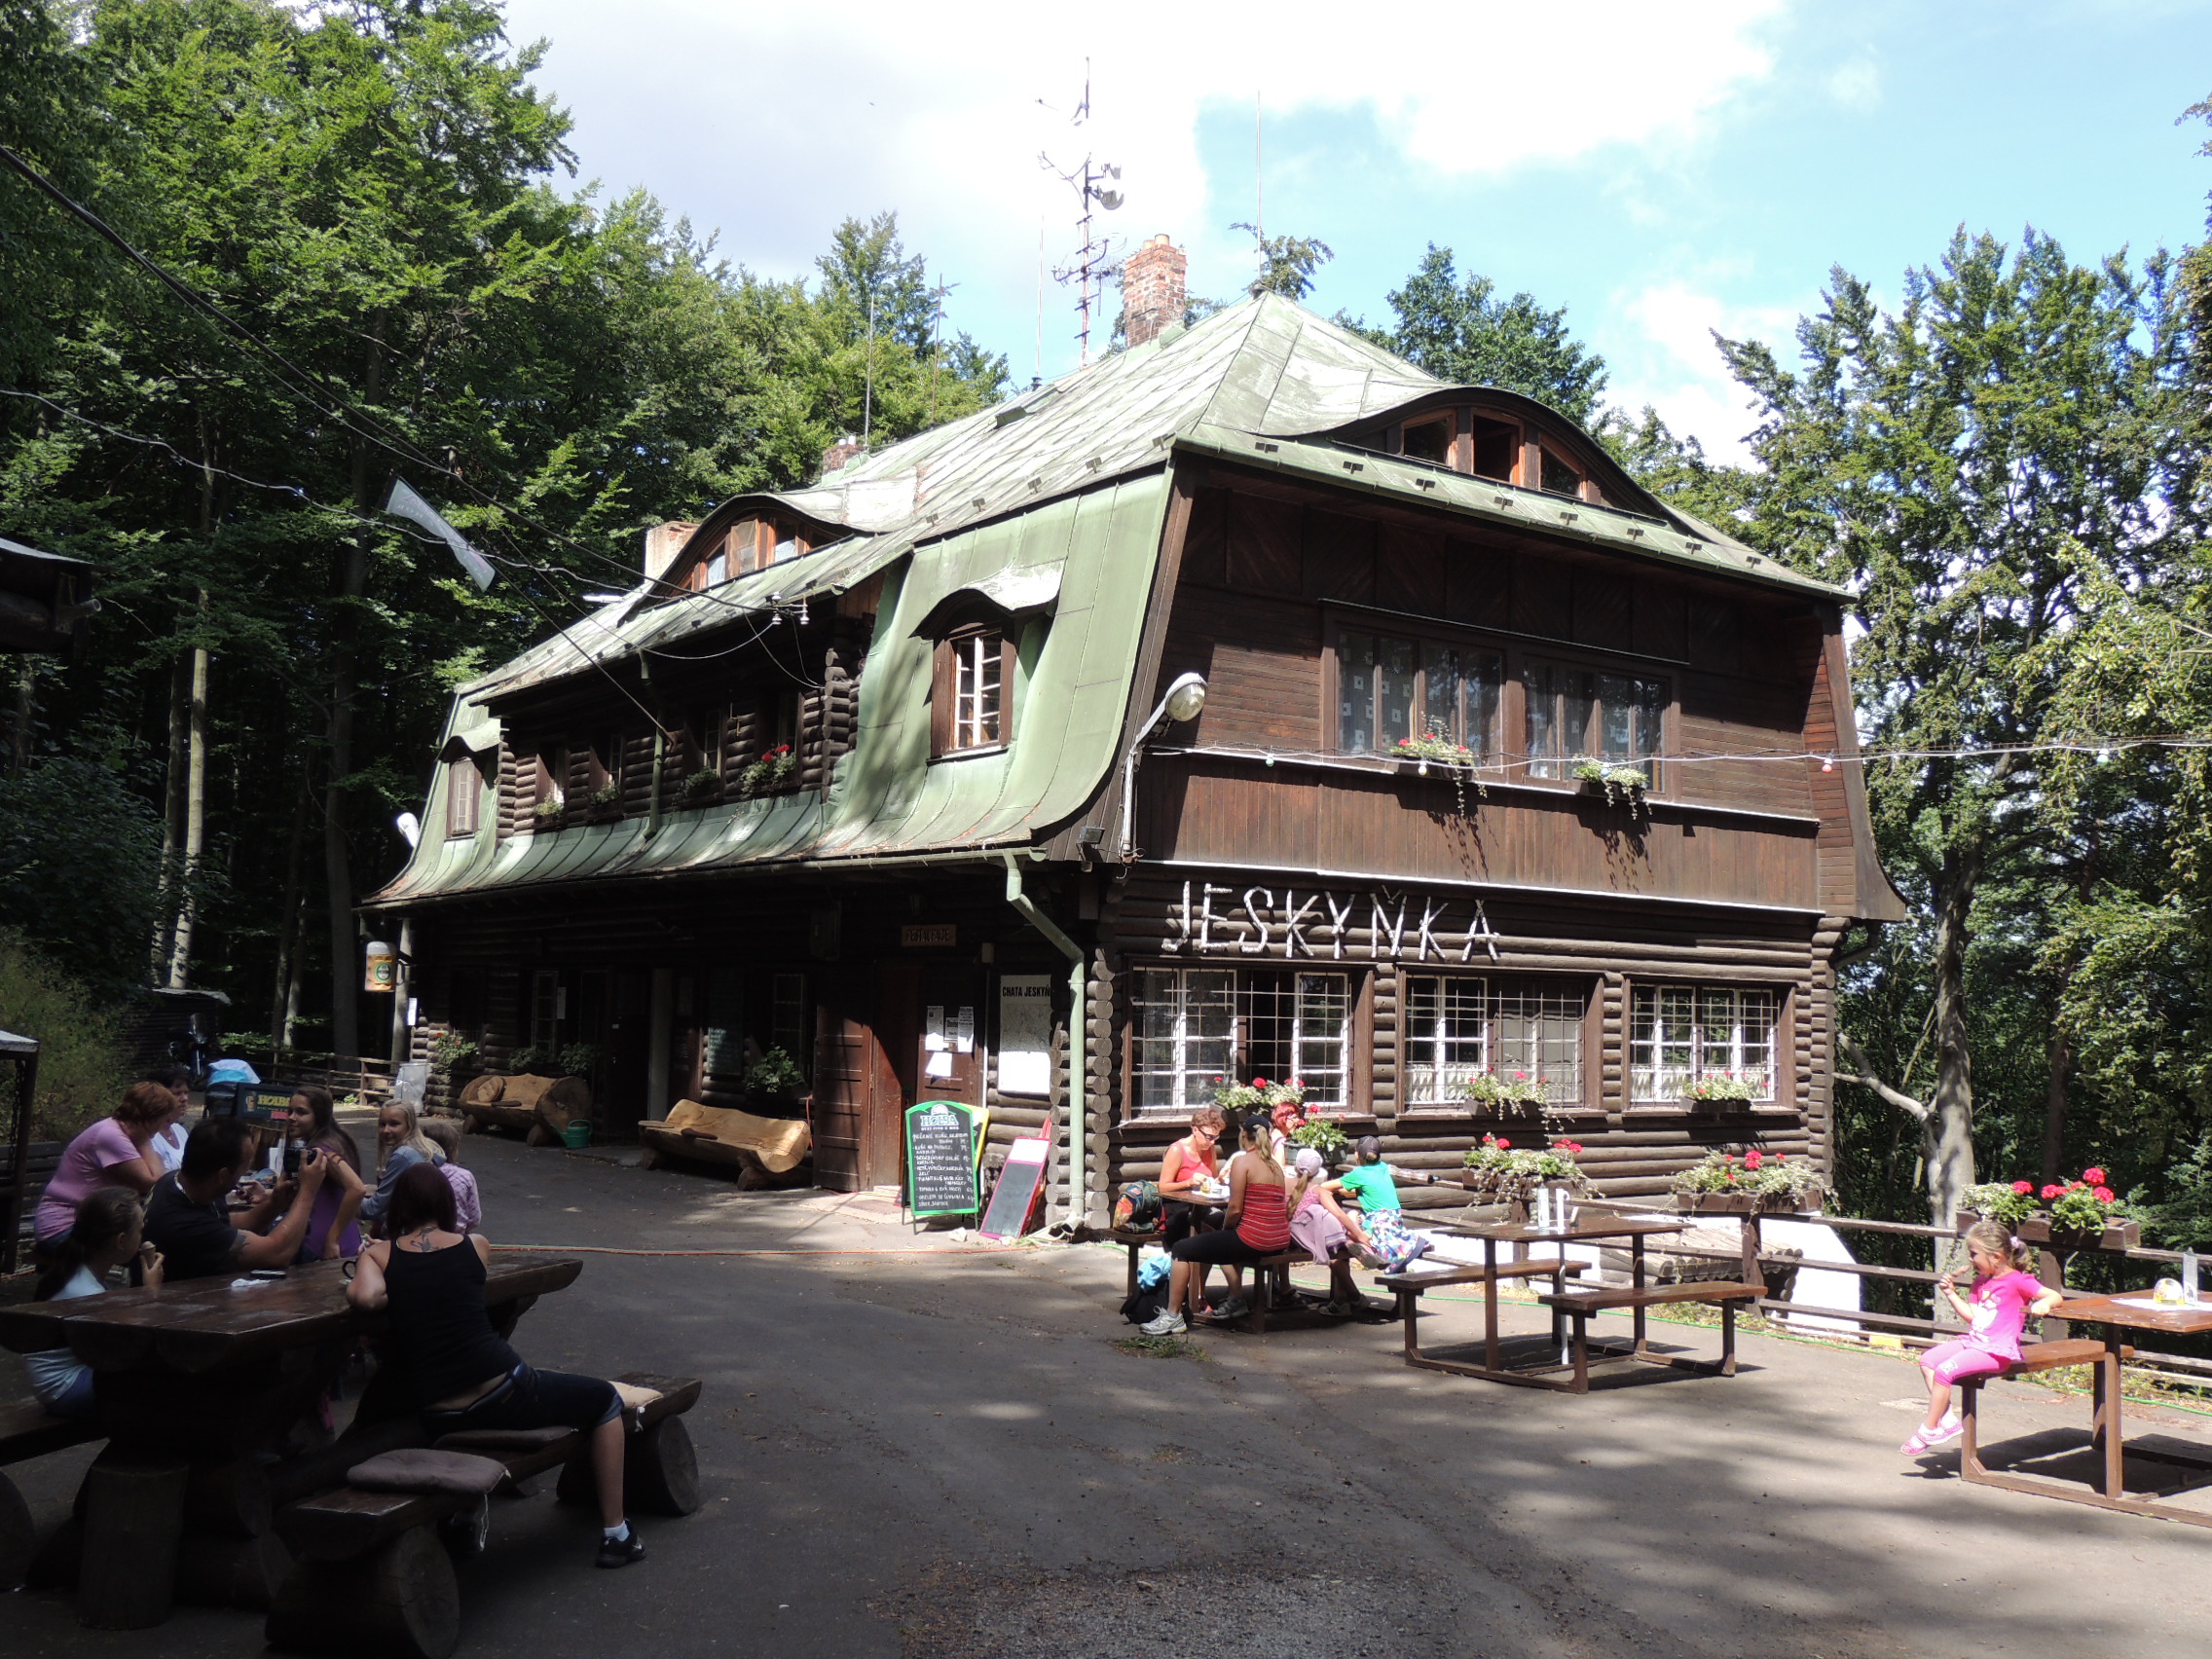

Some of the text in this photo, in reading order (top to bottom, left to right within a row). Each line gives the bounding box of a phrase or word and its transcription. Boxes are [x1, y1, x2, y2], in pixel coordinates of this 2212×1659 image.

[1161, 880, 1500, 962] JESKYŇKA
[1003, 984, 1051, 997] CHATA JESKYŇ
[920, 1115, 959, 1126] HOLBA
